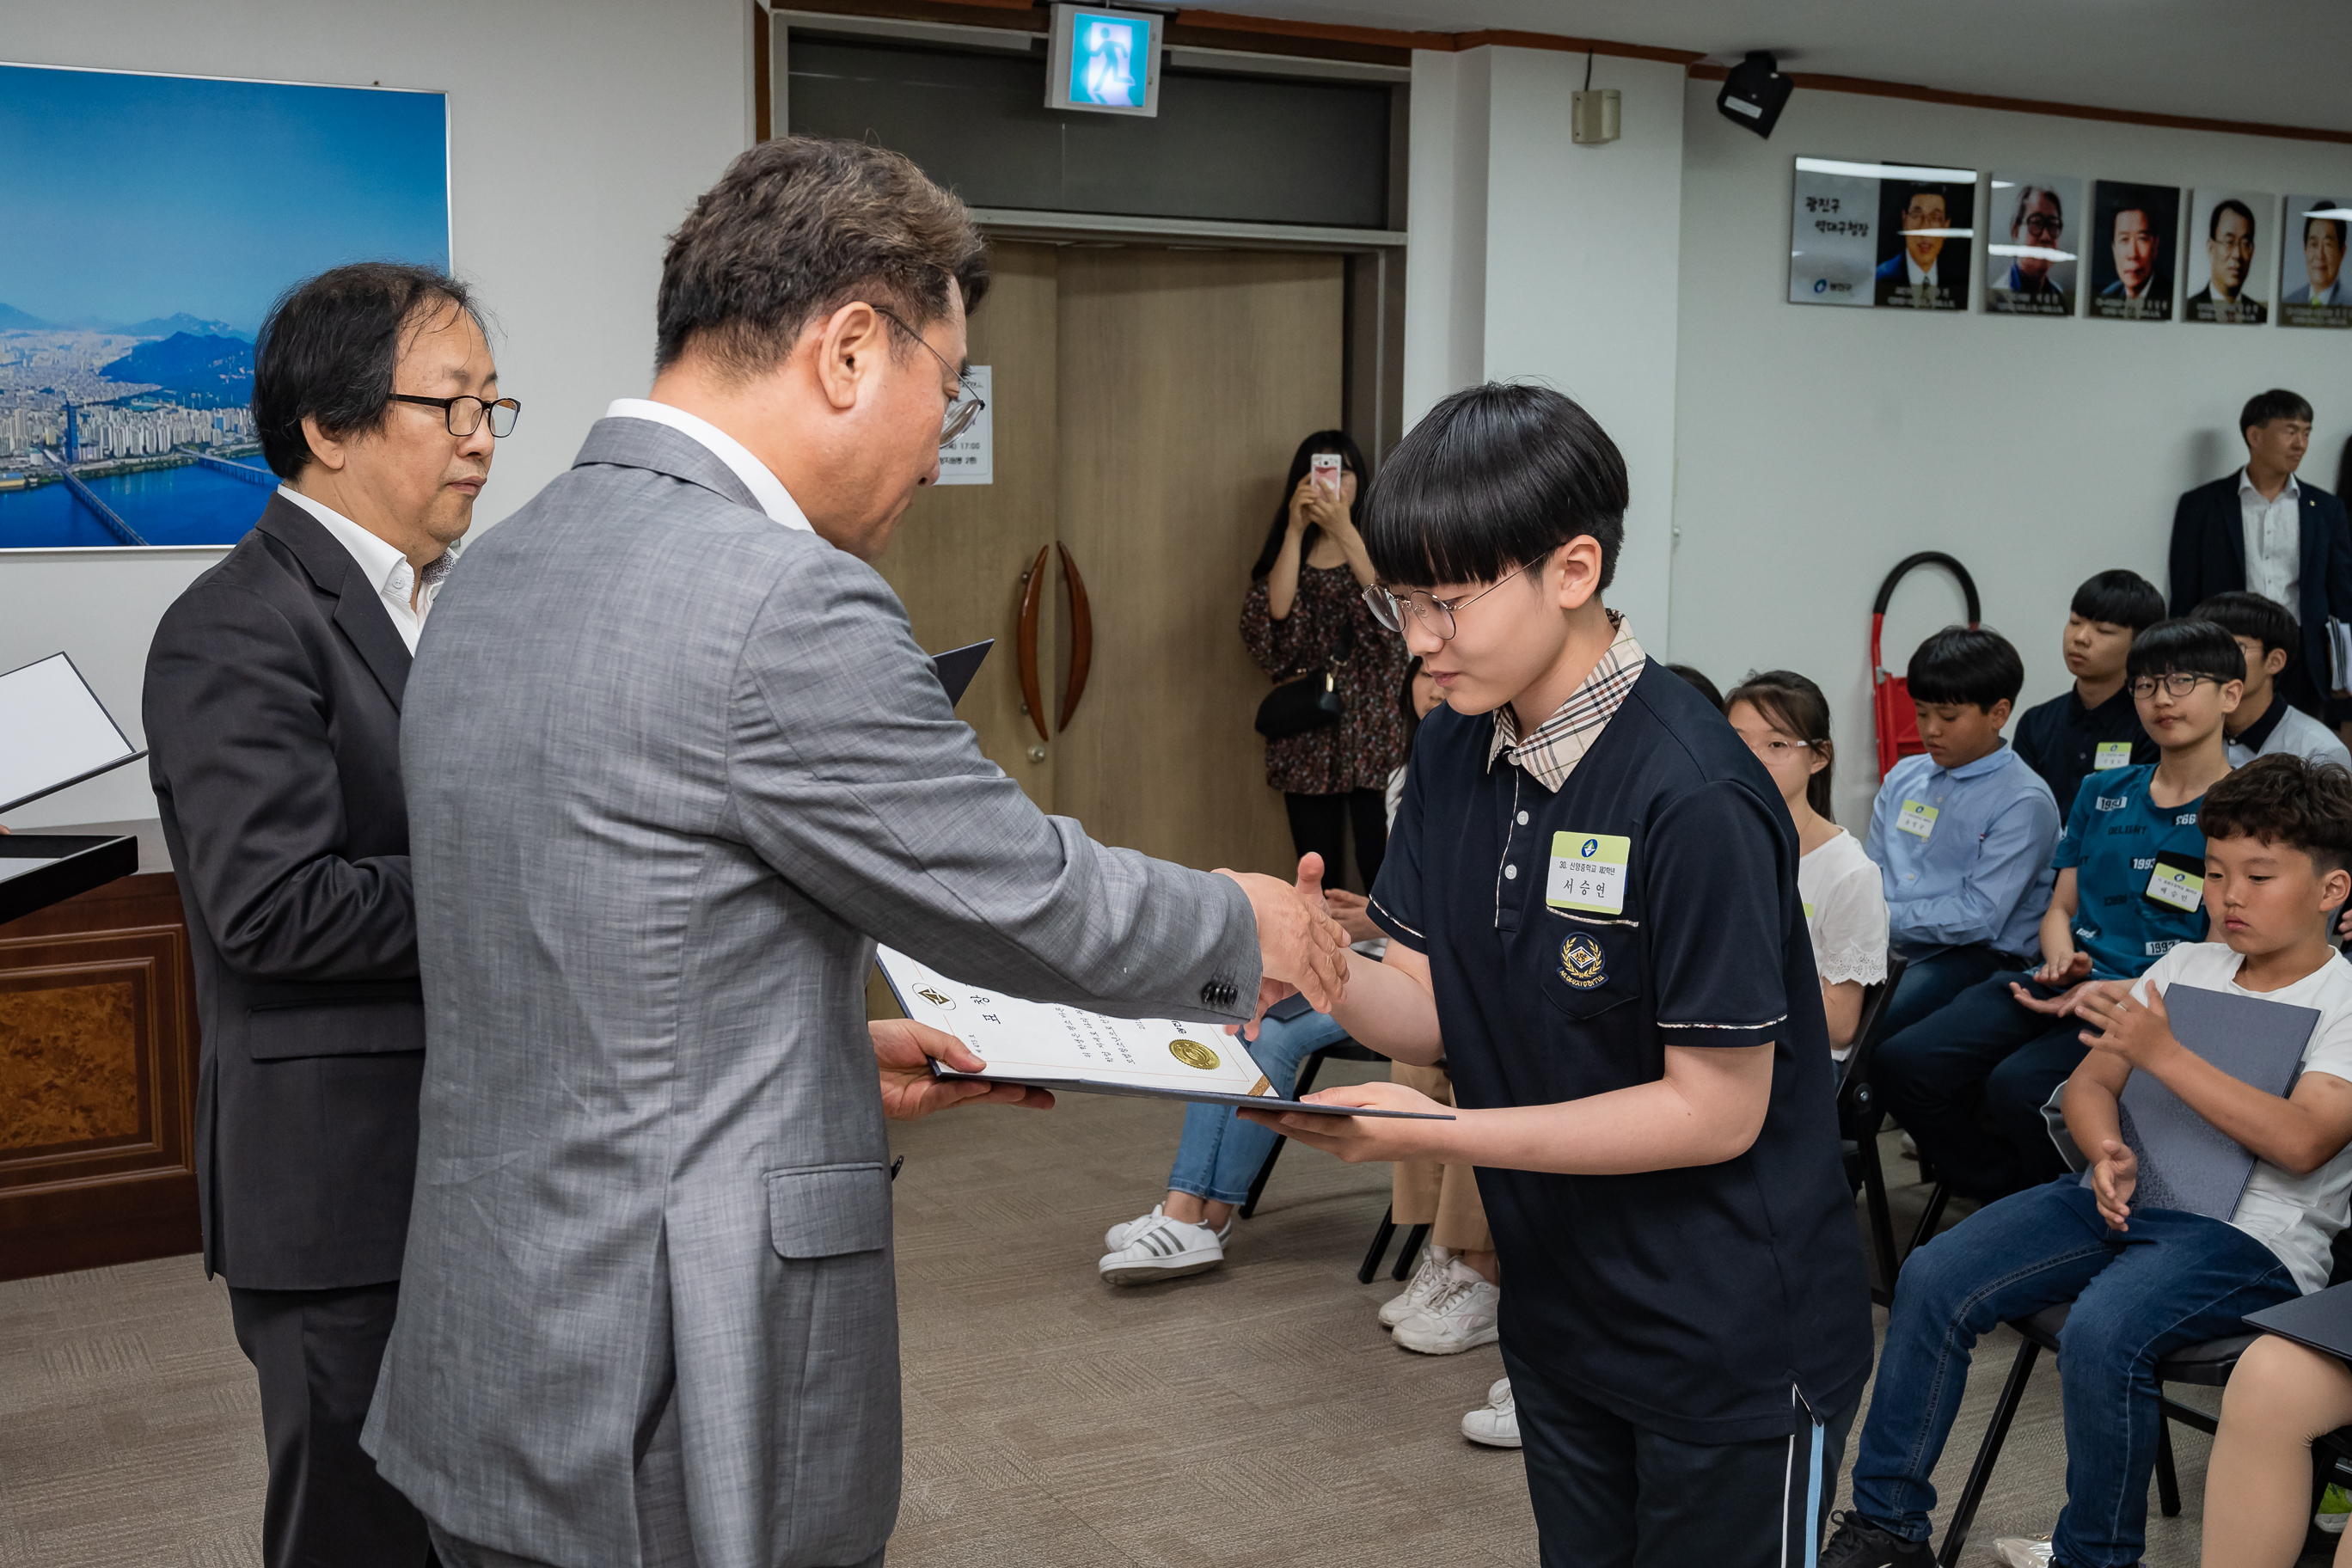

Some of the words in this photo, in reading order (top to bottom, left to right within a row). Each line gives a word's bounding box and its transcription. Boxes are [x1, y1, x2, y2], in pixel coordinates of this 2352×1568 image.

[1805, 197, 1840, 214] 광진구
[1815, 220, 1869, 237] 역대구청장
[970, 995, 990, 1006] 창
[982, 1014, 1001, 1025] 표
